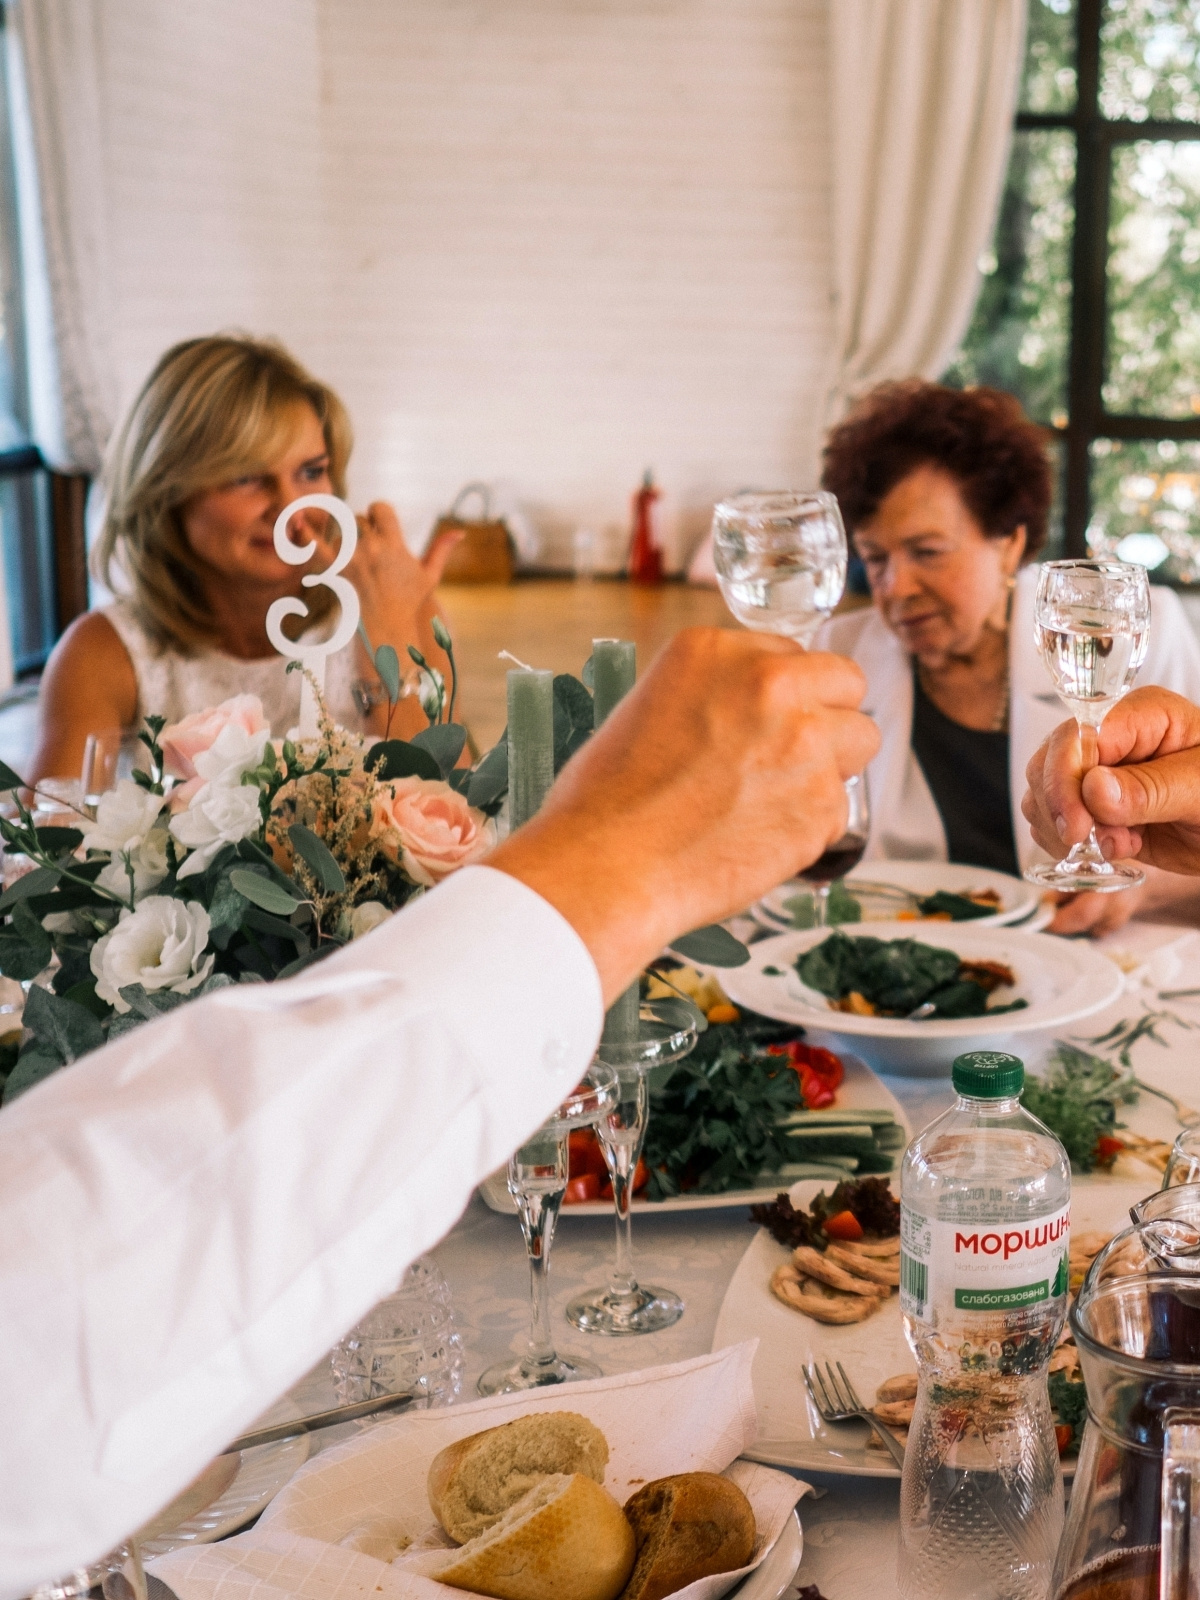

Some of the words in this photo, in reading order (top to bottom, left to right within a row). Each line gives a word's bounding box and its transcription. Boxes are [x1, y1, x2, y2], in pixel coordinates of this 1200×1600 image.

[266, 493, 360, 659] 3
[954, 1262, 988, 1272] Natural
[991, 1261, 1024, 1271] mineral
[961, 1286, 1045, 1304] слабогазована
